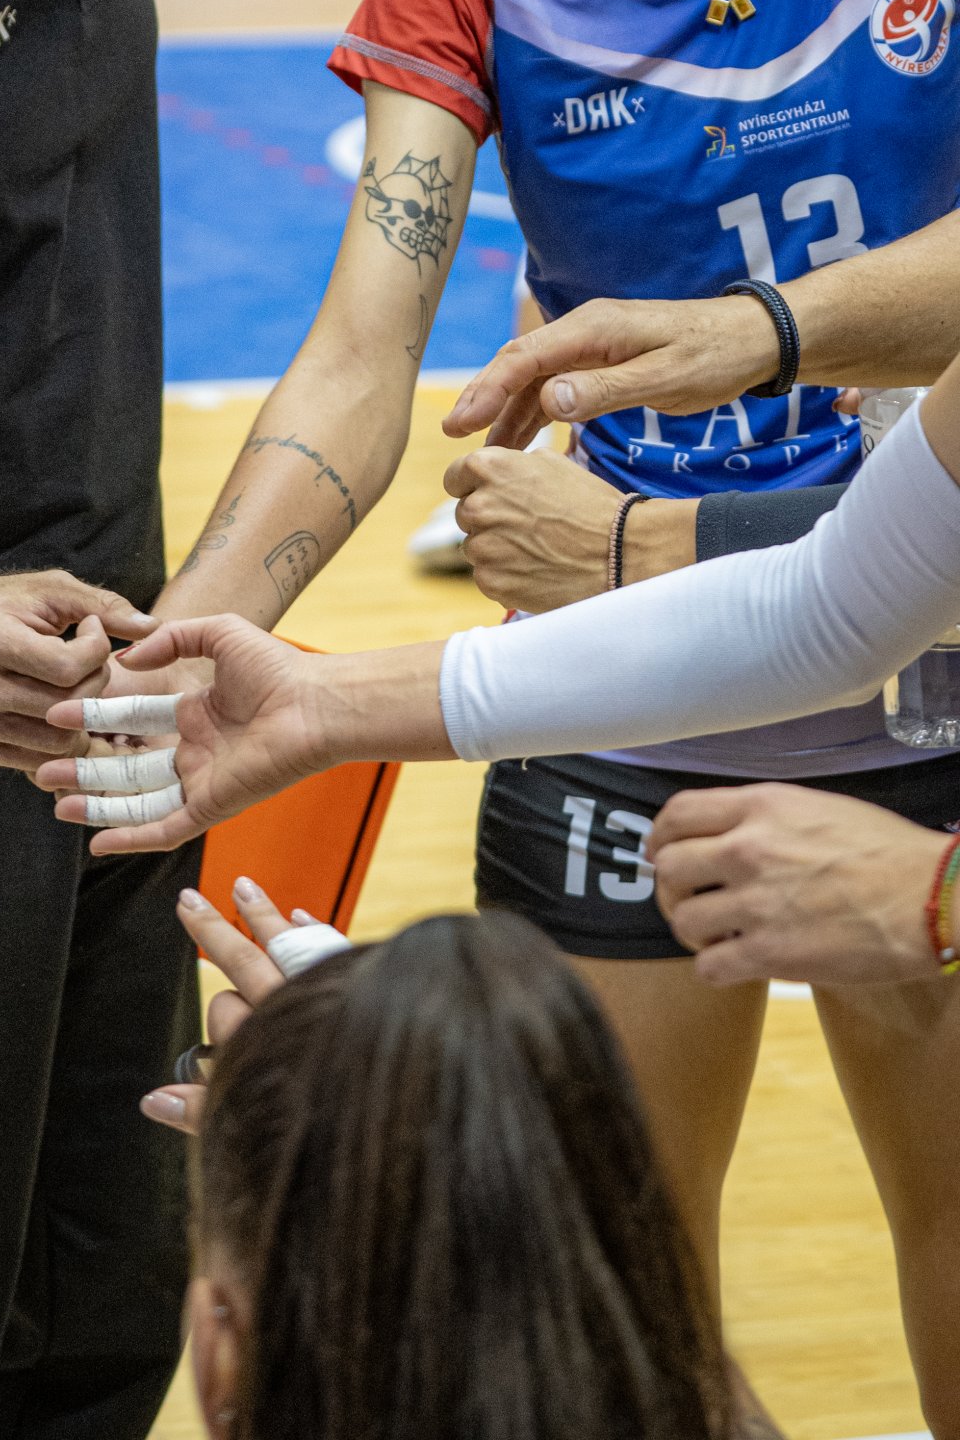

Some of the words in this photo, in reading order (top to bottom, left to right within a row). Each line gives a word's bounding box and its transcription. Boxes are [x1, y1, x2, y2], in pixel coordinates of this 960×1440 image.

[738, 99, 827, 133] NYÍREGYHÁZI
[741, 109, 850, 148] SPORTCENTRUM
[717, 173, 869, 287] 13
[563, 795, 656, 902] 13
